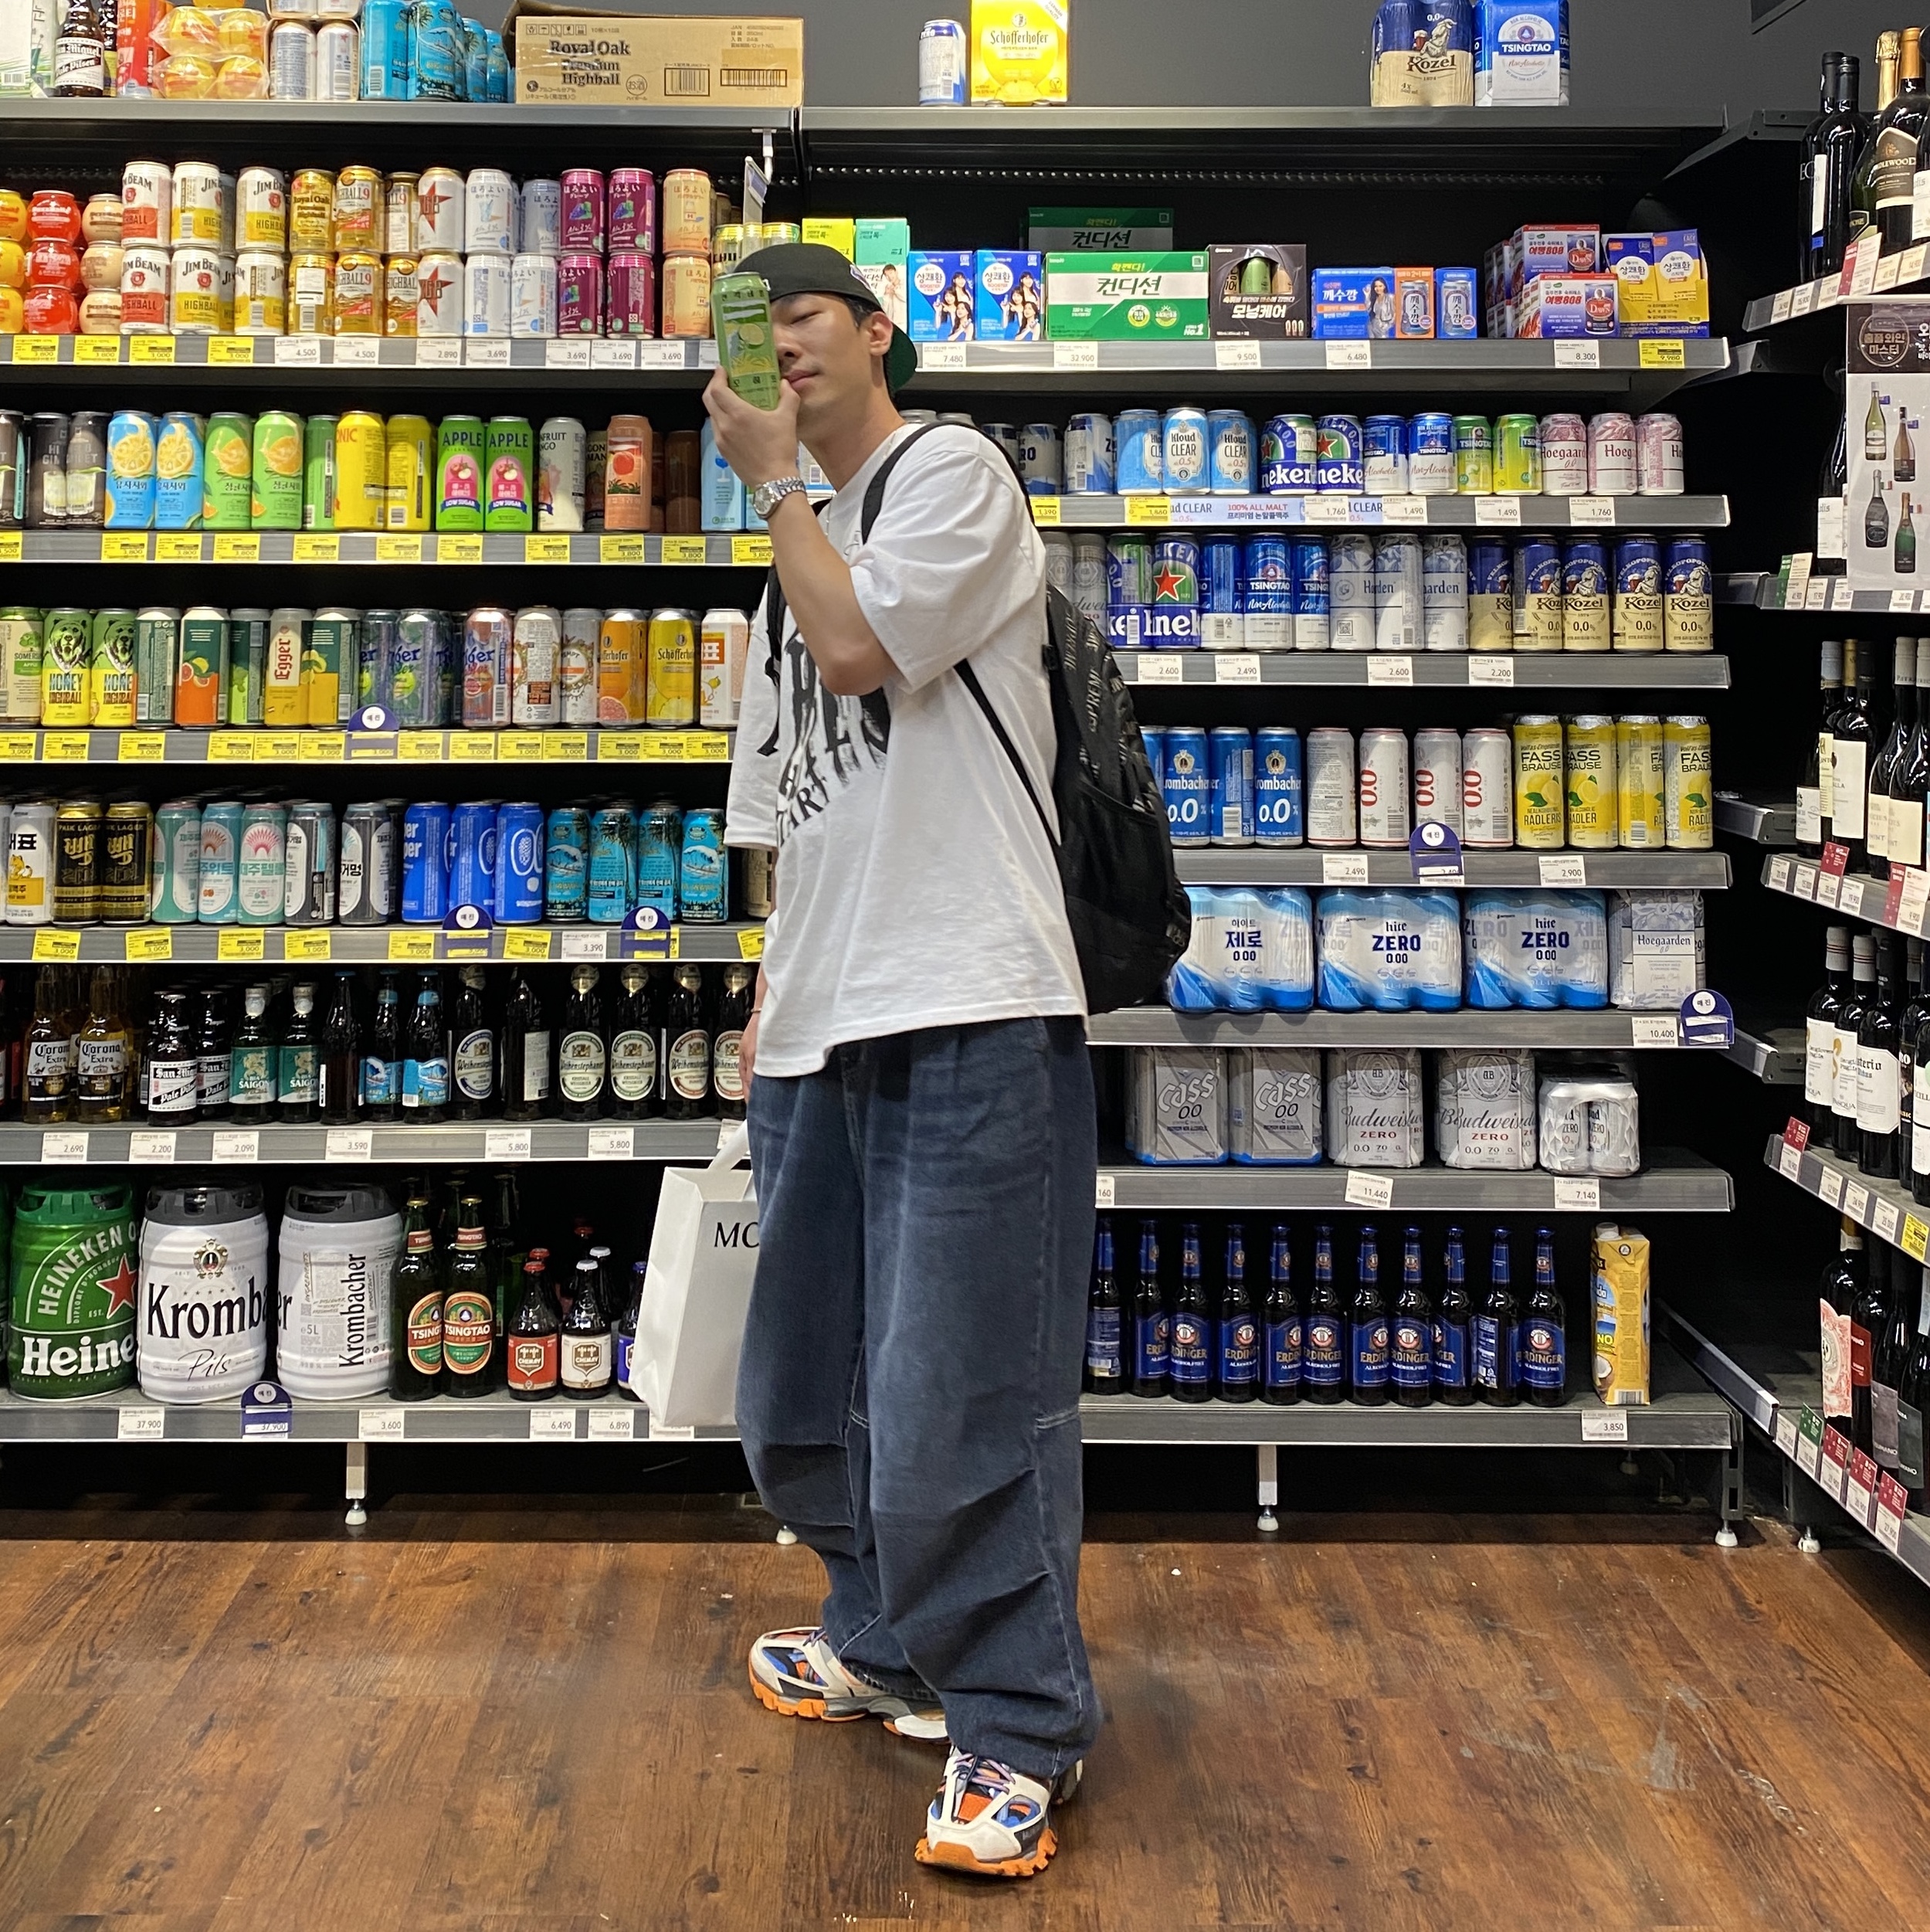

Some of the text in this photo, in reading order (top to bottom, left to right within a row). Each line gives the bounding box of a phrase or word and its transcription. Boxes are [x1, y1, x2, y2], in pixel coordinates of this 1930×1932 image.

[990, 30, 1048, 44] Schöfferhofer
[549, 39, 630, 57] Royal Oak
[1502, 44, 1551, 53] TSINGTAO
[1407, 55, 1457, 73] Kozel
[561, 73, 620, 87] Highball
[563, 185, 597, 193] ほろよい
[293, 195, 330, 205] Royal Oak
[1072, 231, 1131, 249] 컨디션
[134, 257, 161, 277] BEAM
[183, 260, 200, 276] JIM
[1664, 261, 1690, 272] 상쾌환
[917, 272, 944, 287] 상쾌환
[984, 270, 1012, 286] 상쾌환
[1097, 276, 1162, 296] 컨디션
[1322, 290, 1357, 301] 깨수깡
[1232, 305, 1286, 319] 모닝케어
[337, 428, 358, 443] ONIC
[443, 432, 482, 447] APPLE
[489, 433, 528, 447] APPLE
[1171, 433, 1196, 443] Kloud
[1224, 435, 1247, 443] Kloud
[1171, 443, 1196, 456] CLEAR
[1224, 445, 1247, 457] CLEAR
[1183, 504, 1212, 513] CLEAR
[1227, 511, 1253, 520] 프리미엄
[1250, 582, 1291, 591] TSINGTAO
[1564, 597, 1603, 611] Kozel
[1671, 598, 1709, 611] Kozel
[14, 653, 42, 661] SOMERS
[275, 638, 291, 680] Egger
[49, 674, 83, 691] HONEY
[1521, 749, 1561, 763] FASS
[1521, 762, 1561, 771] BRAUSE
[1231, 918, 1256, 929] 하이트
[1386, 921, 1407, 932] hite
[1536, 918, 1555, 929] hite
[1226, 930, 1263, 949] 제로
[1372, 934, 1421, 952] ZERO
[1521, 931, 1569, 949] ZERO
[1638, 934, 1691, 948] Hoegaarden
[82, 1043, 120, 1058] Corona
[90, 1055, 114, 1064] Extra
[1857, 1058, 1882, 1071] sterio
[156, 1068, 175, 1079] San
[161, 1088, 179, 1104] Pale
[1360, 1130, 1397, 1139] ZERO
[1471, 1132, 1509, 1141] ZERO
[1098, 1189, 1111, 1197] 160
[37, 1224, 123, 1316] HEINEKEN
[339, 1254, 366, 1367] Krombacher
[444, 1324, 490, 1336] TSINGTAO
[1596, 1335, 1613, 1344] NO
[21, 1336, 134, 1377] Heine
[178, 1349, 231, 1381] Pils
